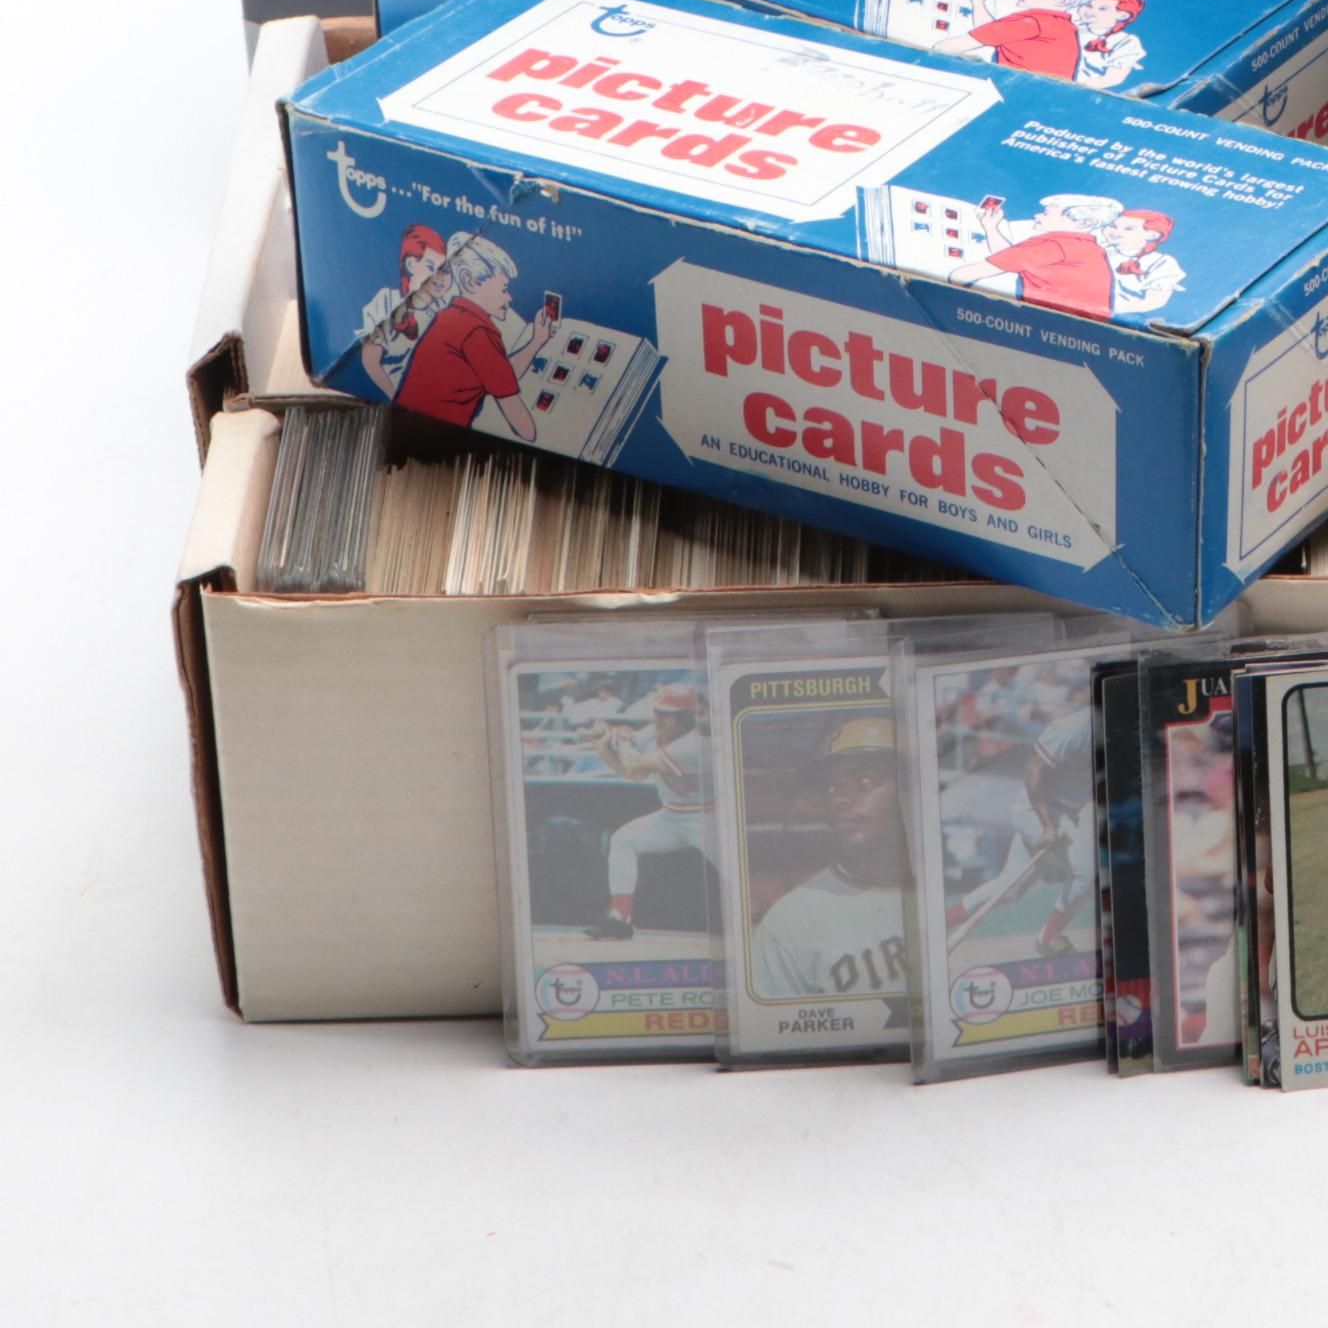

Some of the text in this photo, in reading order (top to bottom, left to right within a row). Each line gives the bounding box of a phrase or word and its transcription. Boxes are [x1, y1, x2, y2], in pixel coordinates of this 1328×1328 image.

[590, 2, 656, 39] topps
[1251, 27, 1300, 72] 500-COUNT
[485, 46, 882, 155] picture
[490, 92, 799, 181] cards
[1010, 130, 1295, 202] publisher of Picture Cards for
[1023, 120, 1304, 195] Produced by the world's largest
[1122, 116, 1210, 141] 500-COUNT
[1215, 137, 1285, 162] VENDING
[326, 140, 387, 219] topps
[454, 193, 487, 219] the
[490, 205, 523, 229] fun
[526, 213, 547, 235] of
[1001, 137, 1286, 210] America's fastest growing hobby!
[956, 307, 1145, 367] 500-COUNT VENDING PACK
[701, 302, 1061, 446] picture
[742, 391, 1027, 511] cards
[701, 434, 1073, 549] AN EDUCATIONAL HOBBY FOR BOYS AND GIRLS
[750, 675, 871, 700] PITTSBURGH
[611, 992, 675, 1008] PETE
[644, 1012, 730, 1032] REDS
[778, 1016, 855, 1035] PARKER
[798, 1007, 836, 1020] DAVE
[1020, 989, 1063, 1006] JOE
